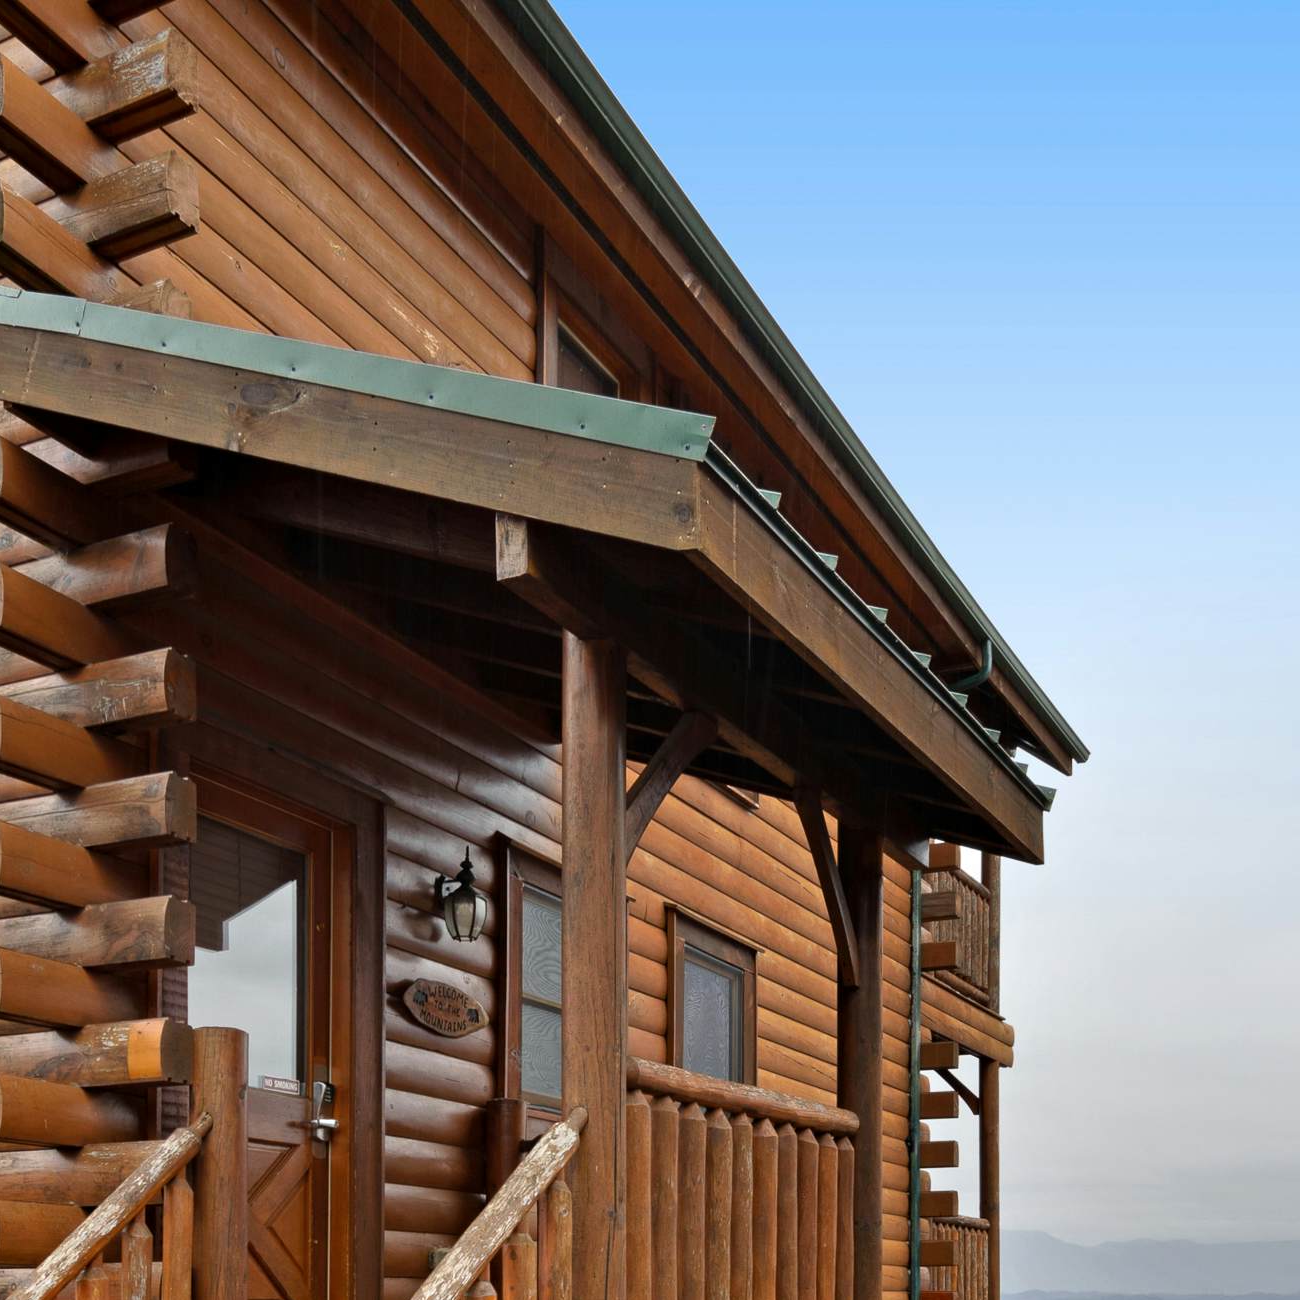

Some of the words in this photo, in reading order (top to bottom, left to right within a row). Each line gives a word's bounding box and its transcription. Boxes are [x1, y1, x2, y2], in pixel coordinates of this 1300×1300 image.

[427, 984, 469, 1009] WELCOME
[434, 1000, 443, 1010] TO
[447, 1004, 461, 1017] THE
[420, 1008, 467, 1033] MOUNTAINS
[264, 1078, 273, 1088] NO
[274, 1080, 298, 1092] SMOKING
